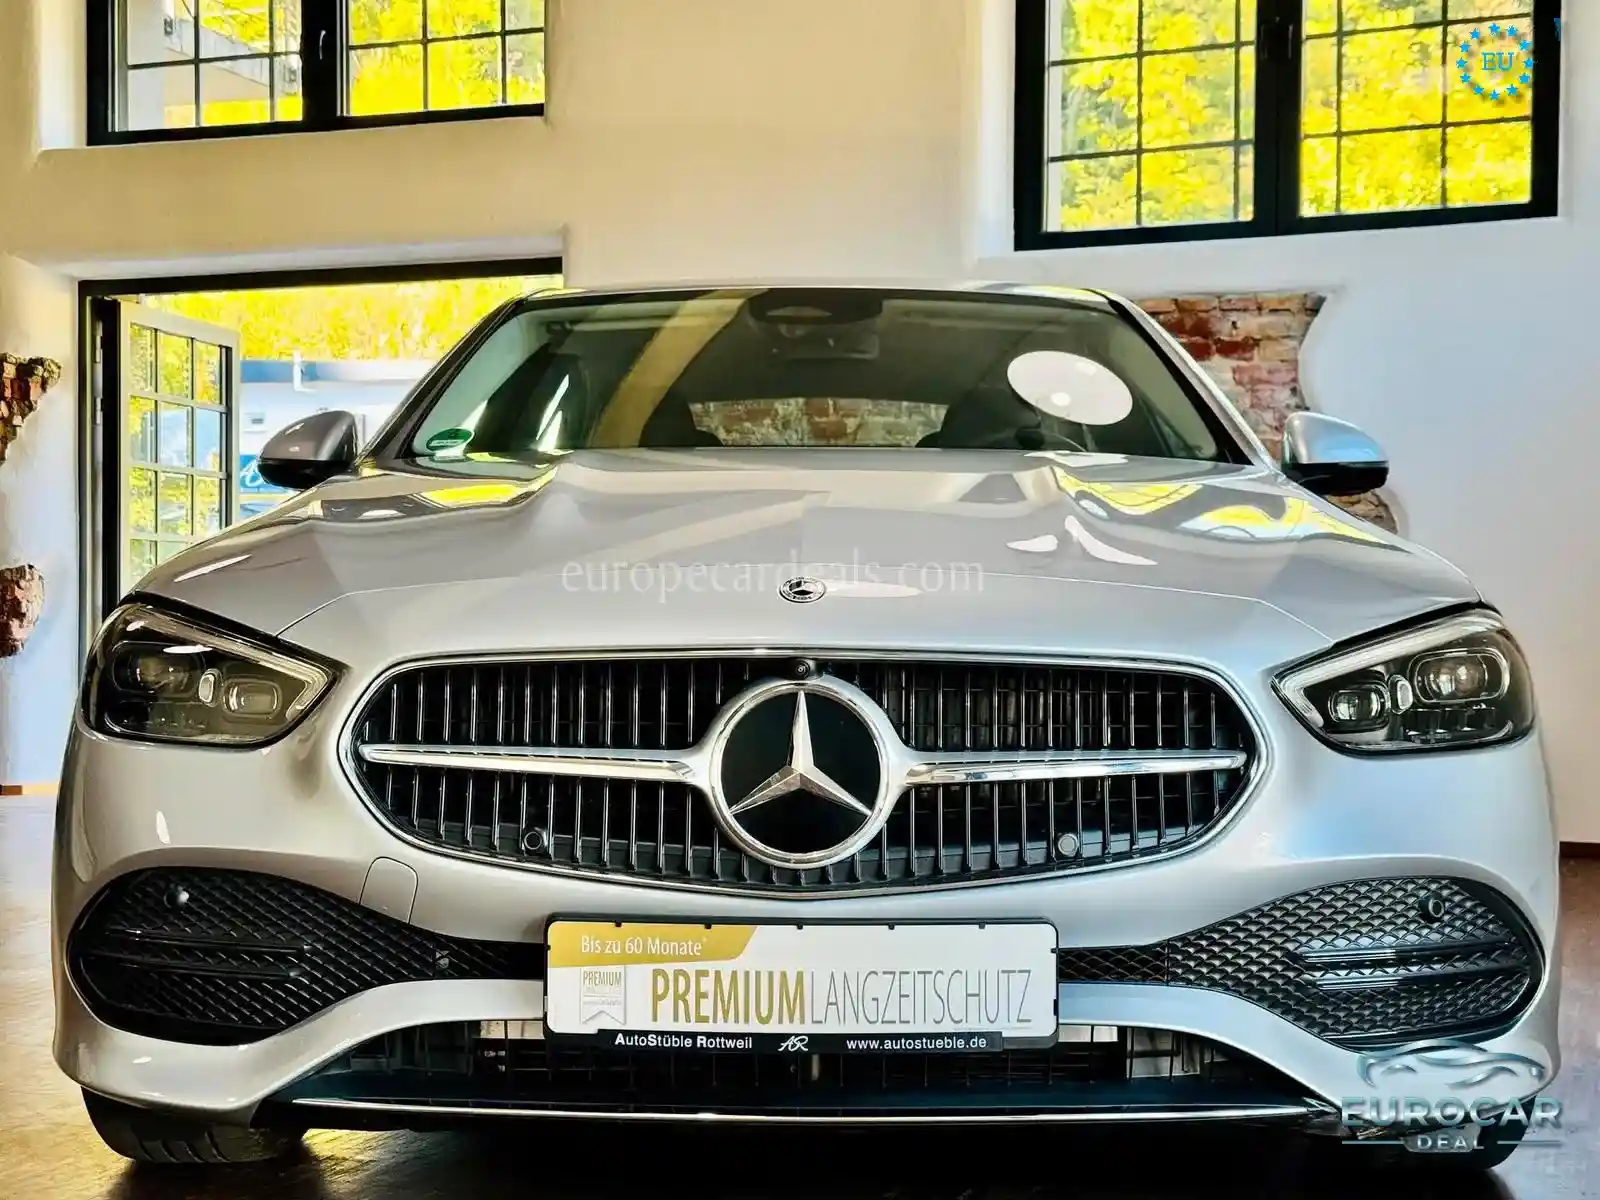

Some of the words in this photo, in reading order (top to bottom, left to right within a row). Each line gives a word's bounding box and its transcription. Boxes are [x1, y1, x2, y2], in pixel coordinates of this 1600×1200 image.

[581, 935, 601, 953] Bis
[604, 940, 621, 953] zu
[625, 937, 643, 953] 60
[583, 971, 622, 986] PREMIUM
[614, 1033, 693, 1048] AutoStüble
[696, 1035, 753, 1049] Rottweil
[846, 1036, 987, 1050] www.autostueble.de
